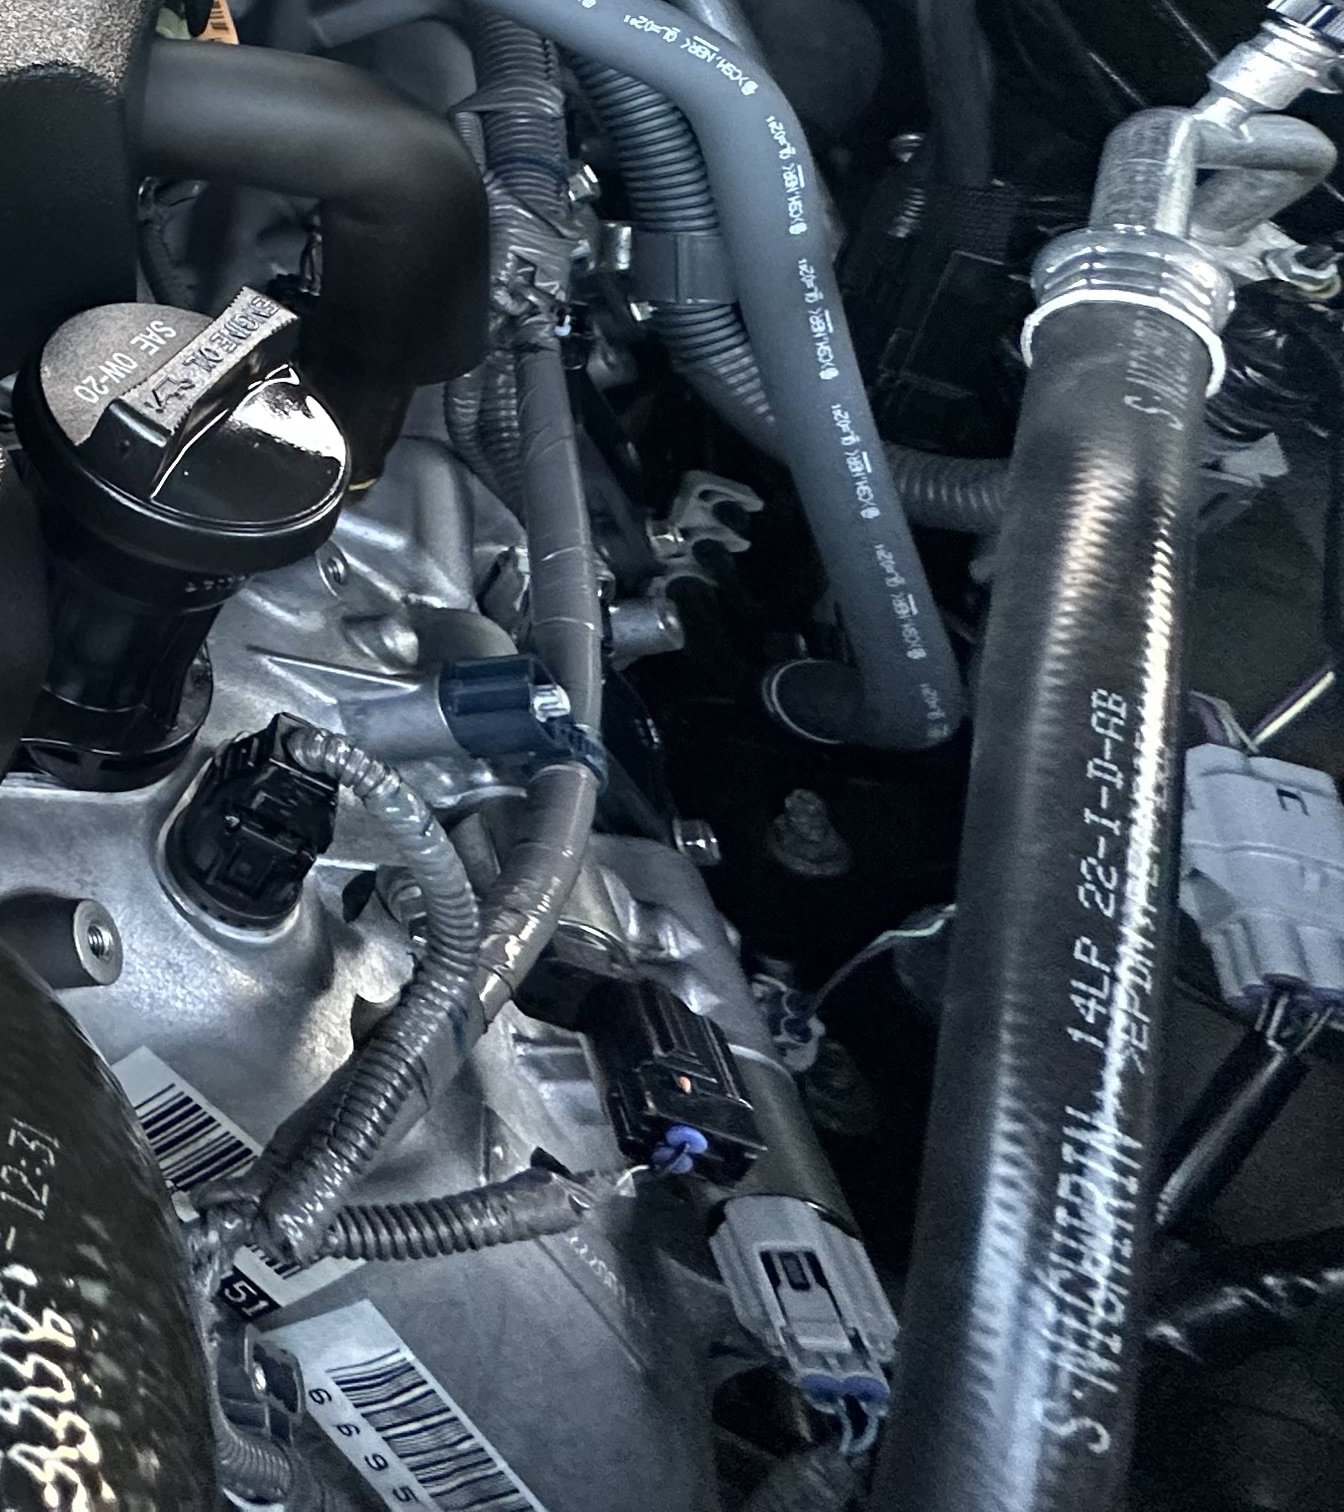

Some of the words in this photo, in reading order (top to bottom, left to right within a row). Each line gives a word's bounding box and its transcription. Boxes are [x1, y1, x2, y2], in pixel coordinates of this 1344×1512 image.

[129, 320, 177, 356] SAE
[209, 294, 280, 354] ENGINE
[1065, 936, 1114, 1048] 14LP
